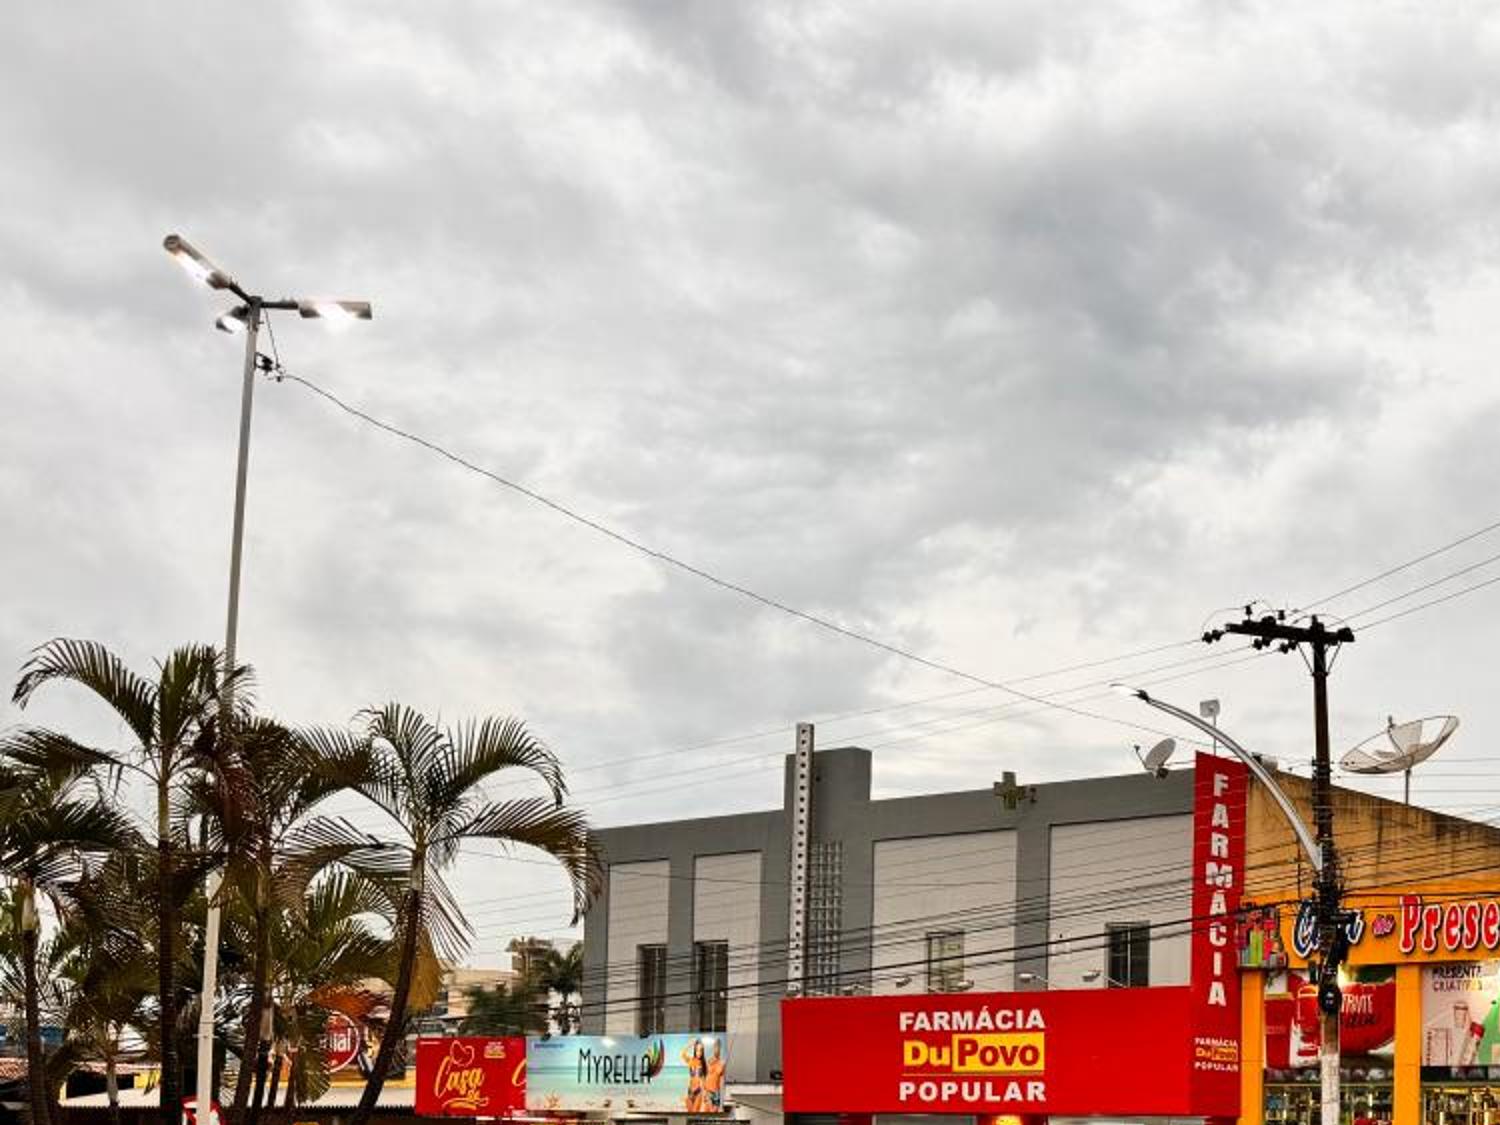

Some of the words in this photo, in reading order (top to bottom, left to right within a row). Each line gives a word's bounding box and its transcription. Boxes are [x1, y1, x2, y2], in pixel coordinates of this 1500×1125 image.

[899, 1005, 1047, 1032] FARMÁCIA
[578, 1048, 651, 1085] MYRELLA
[903, 1039, 951, 1067] Du
[434, 1055, 485, 1099] Casa
[899, 1081, 1047, 1102] POPULAR
